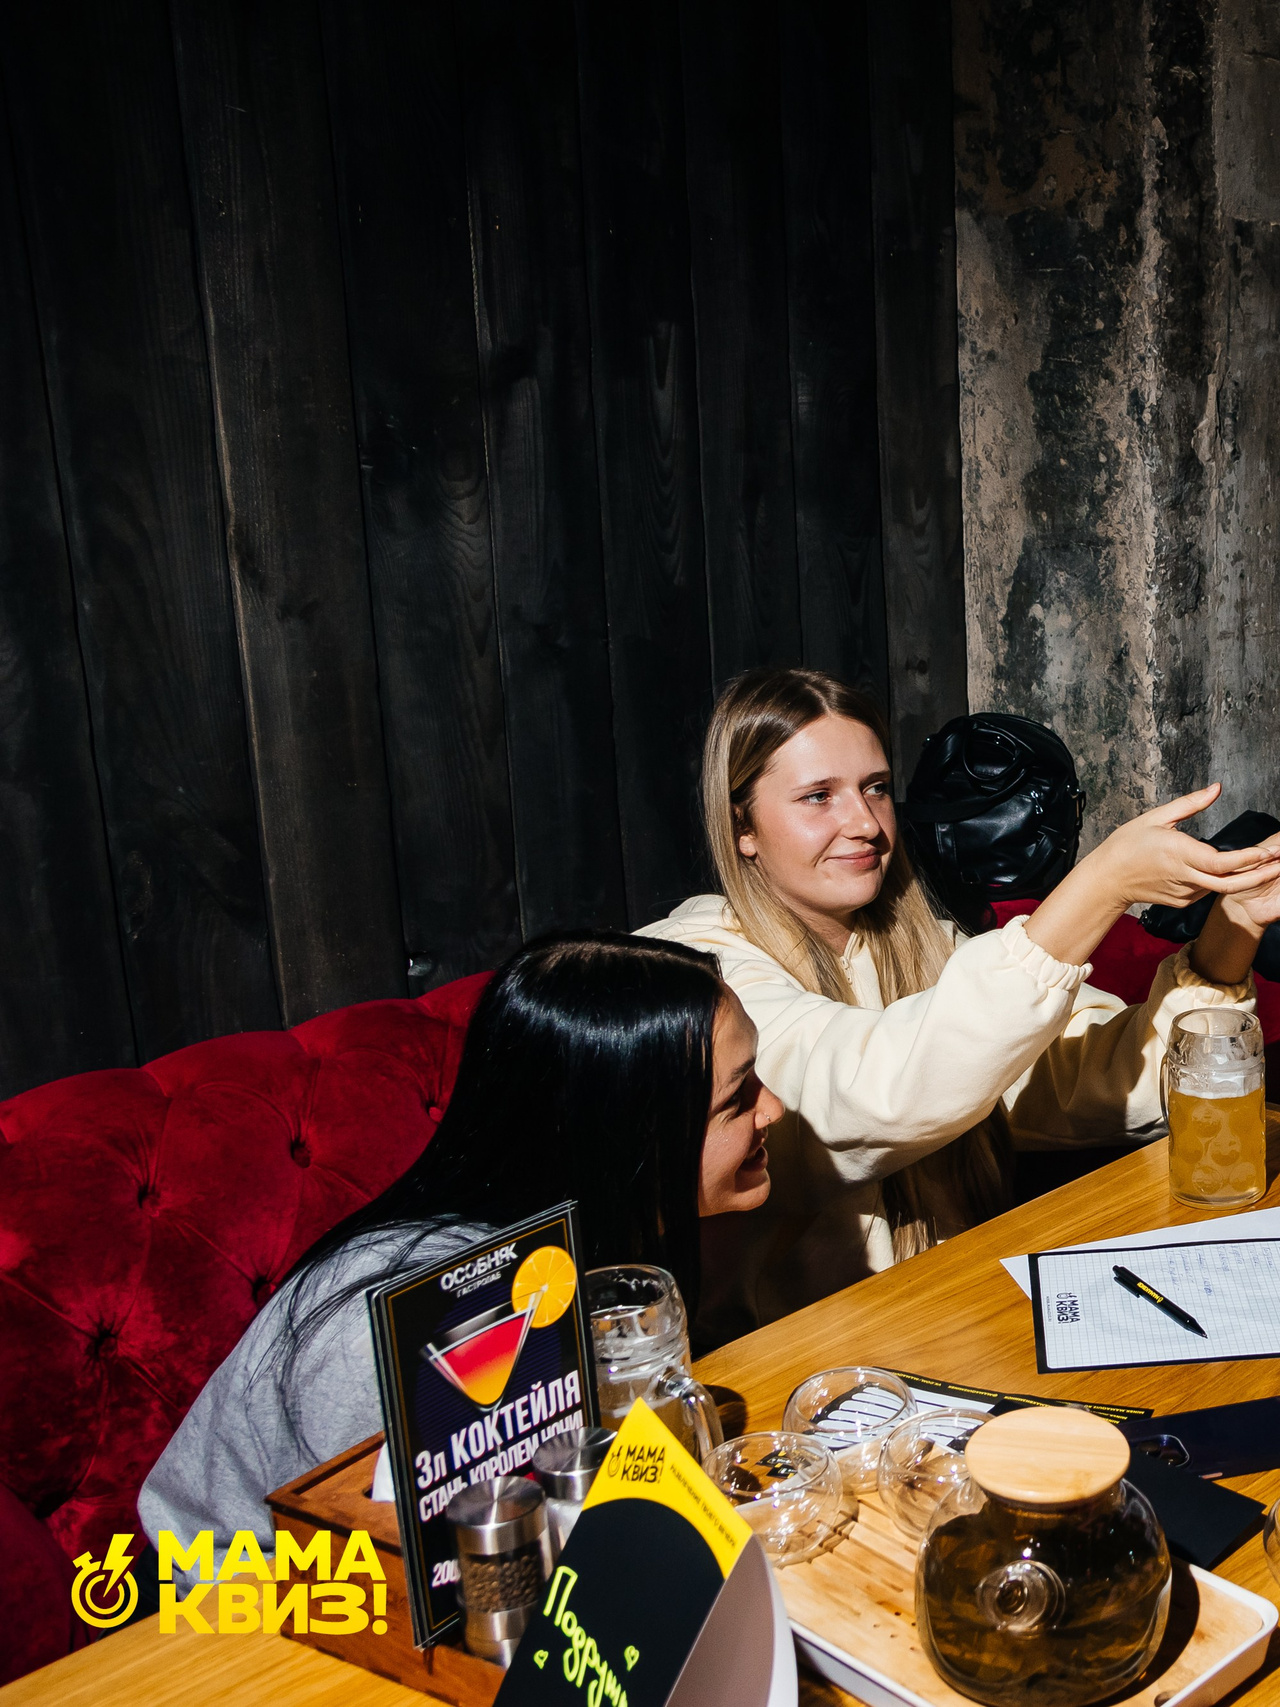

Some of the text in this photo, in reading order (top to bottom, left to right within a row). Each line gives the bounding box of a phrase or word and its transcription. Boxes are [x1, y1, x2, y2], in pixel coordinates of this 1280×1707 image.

[1055, 1300, 1069, 1325] КВИЗ!
[1068, 1300, 1081, 1324] МАМА
[451, 1369, 582, 1467] КОКТЕЙЛЯ
[470, 1432, 538, 1486] КОРОЛЕМ
[624, 1444, 667, 1464] МАМА
[620, 1463, 664, 1484] КВИЗ!
